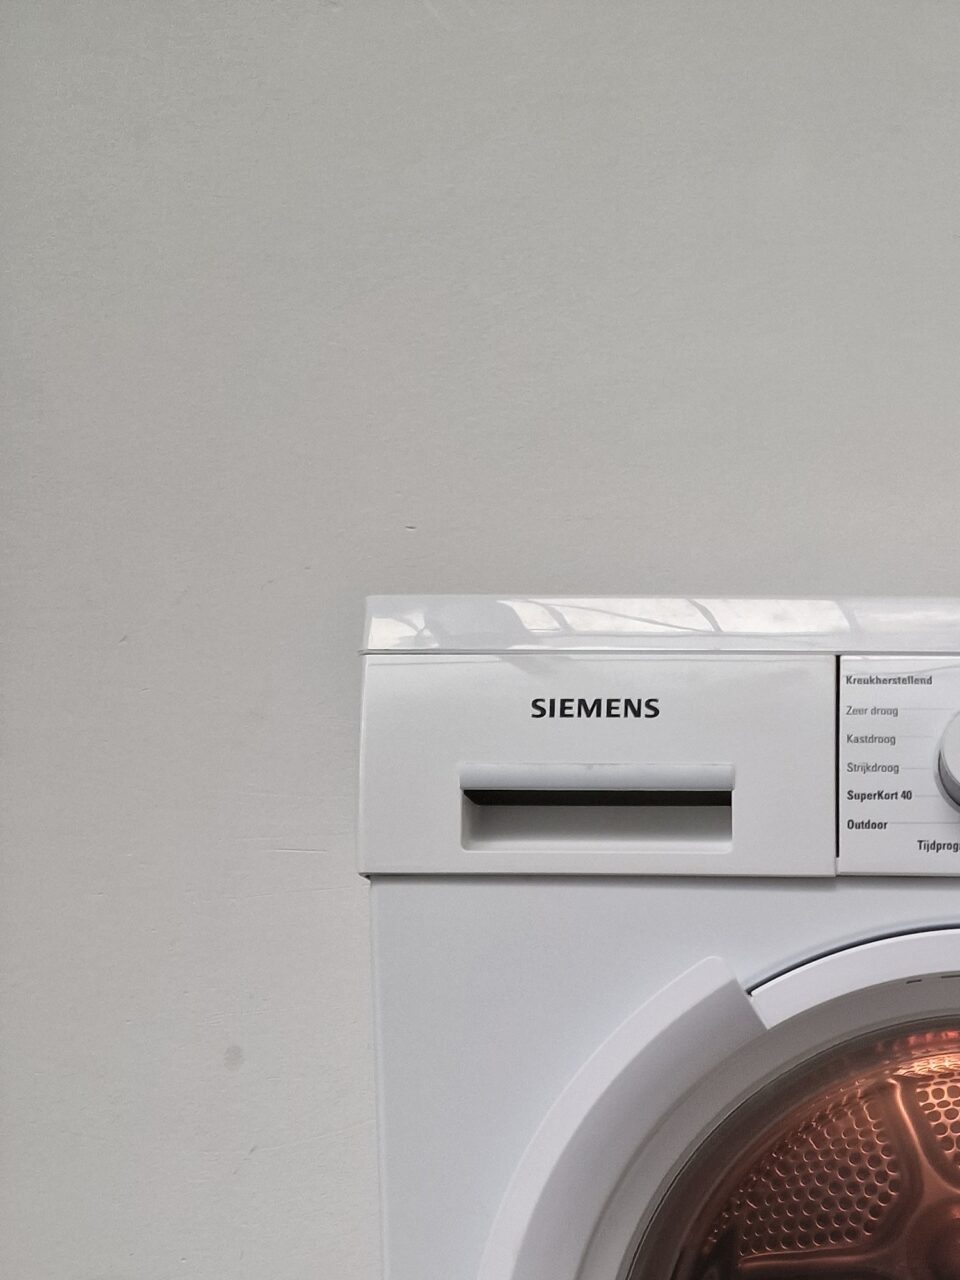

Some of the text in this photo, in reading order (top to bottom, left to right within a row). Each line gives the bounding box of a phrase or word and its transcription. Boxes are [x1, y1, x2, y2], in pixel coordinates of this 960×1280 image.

[845, 675, 933, 686] Kreukherstellend
[531, 698, 660, 719] SIEMENS
[845, 705, 899, 719] Zeer droog
[846, 735, 896, 746] Kastdroog
[846, 763, 900, 774] Strijkdroog
[846, 790, 912, 802] SuperKort 40
[847, 819, 888, 830] Outdoor
